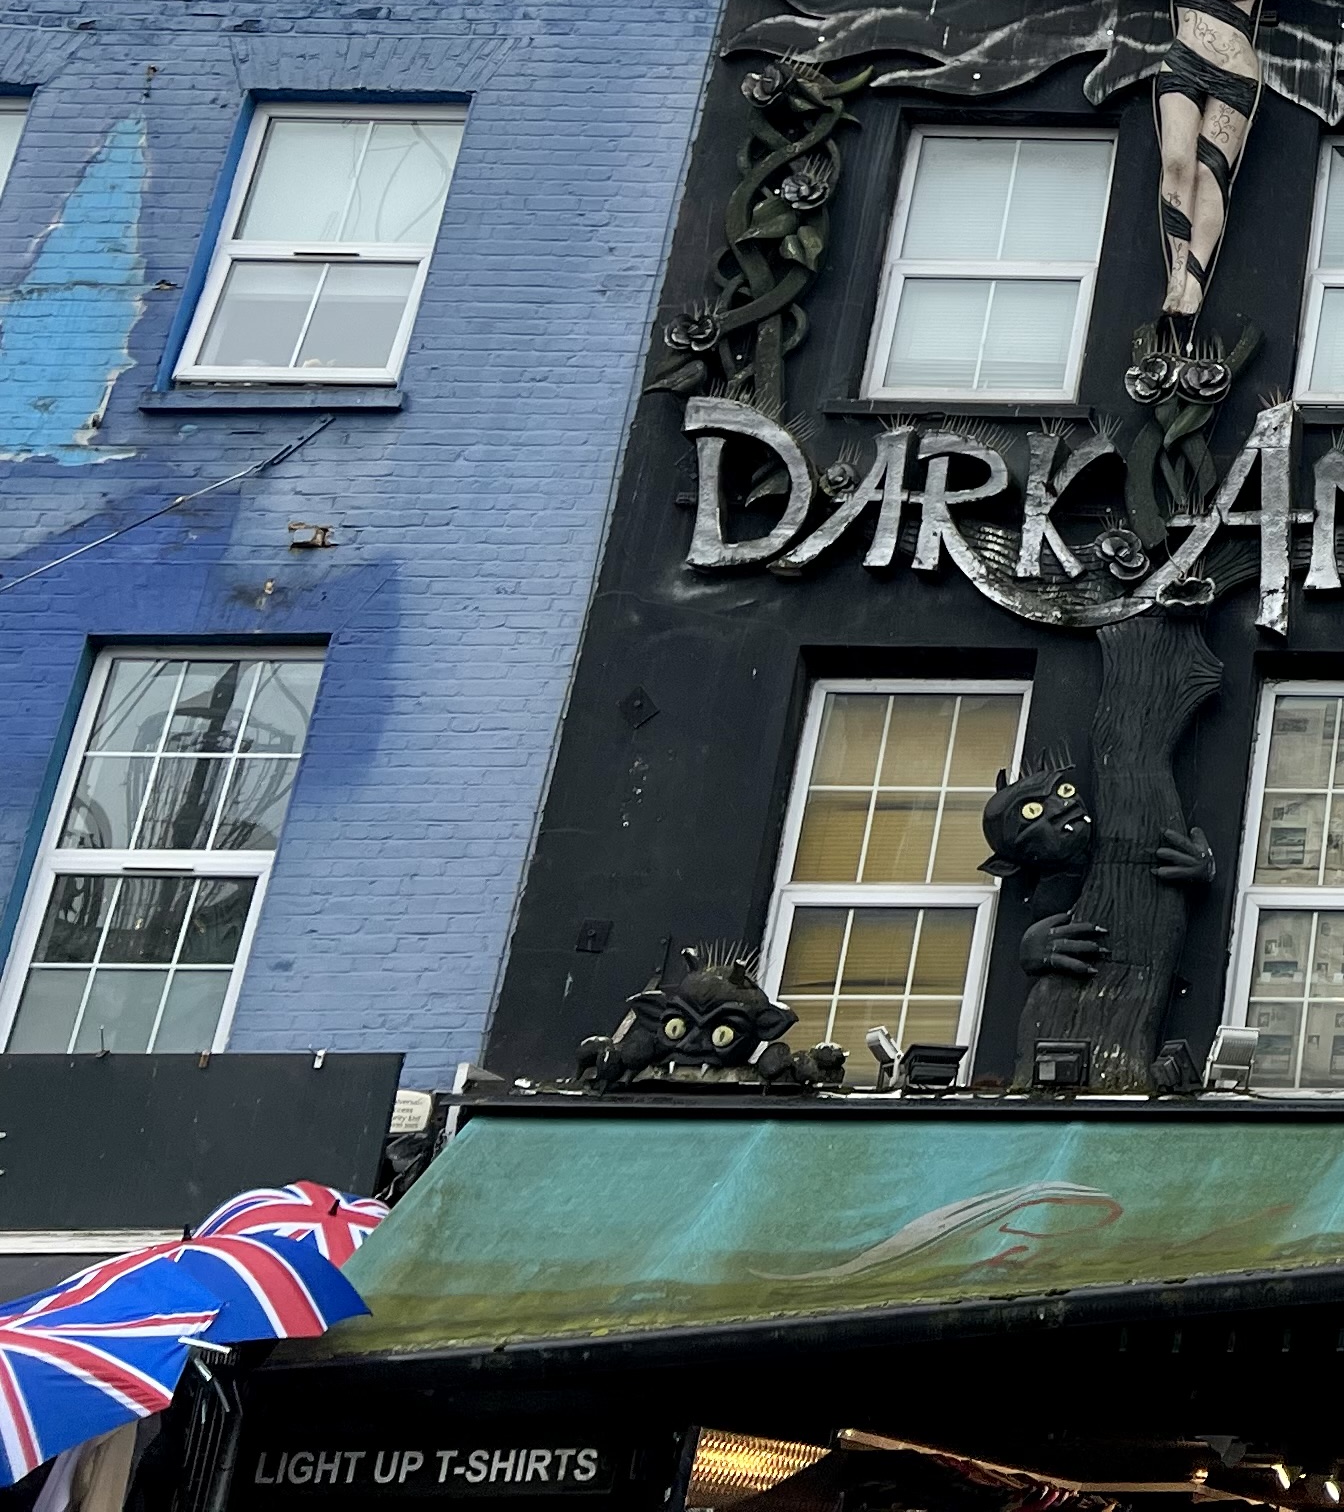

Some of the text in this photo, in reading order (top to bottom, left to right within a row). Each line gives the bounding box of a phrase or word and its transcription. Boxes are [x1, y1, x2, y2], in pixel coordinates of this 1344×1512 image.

[683, 396, 1155, 628] DARK
[255, 1448, 598, 1484] LIGHT UP T-SHIRTS
